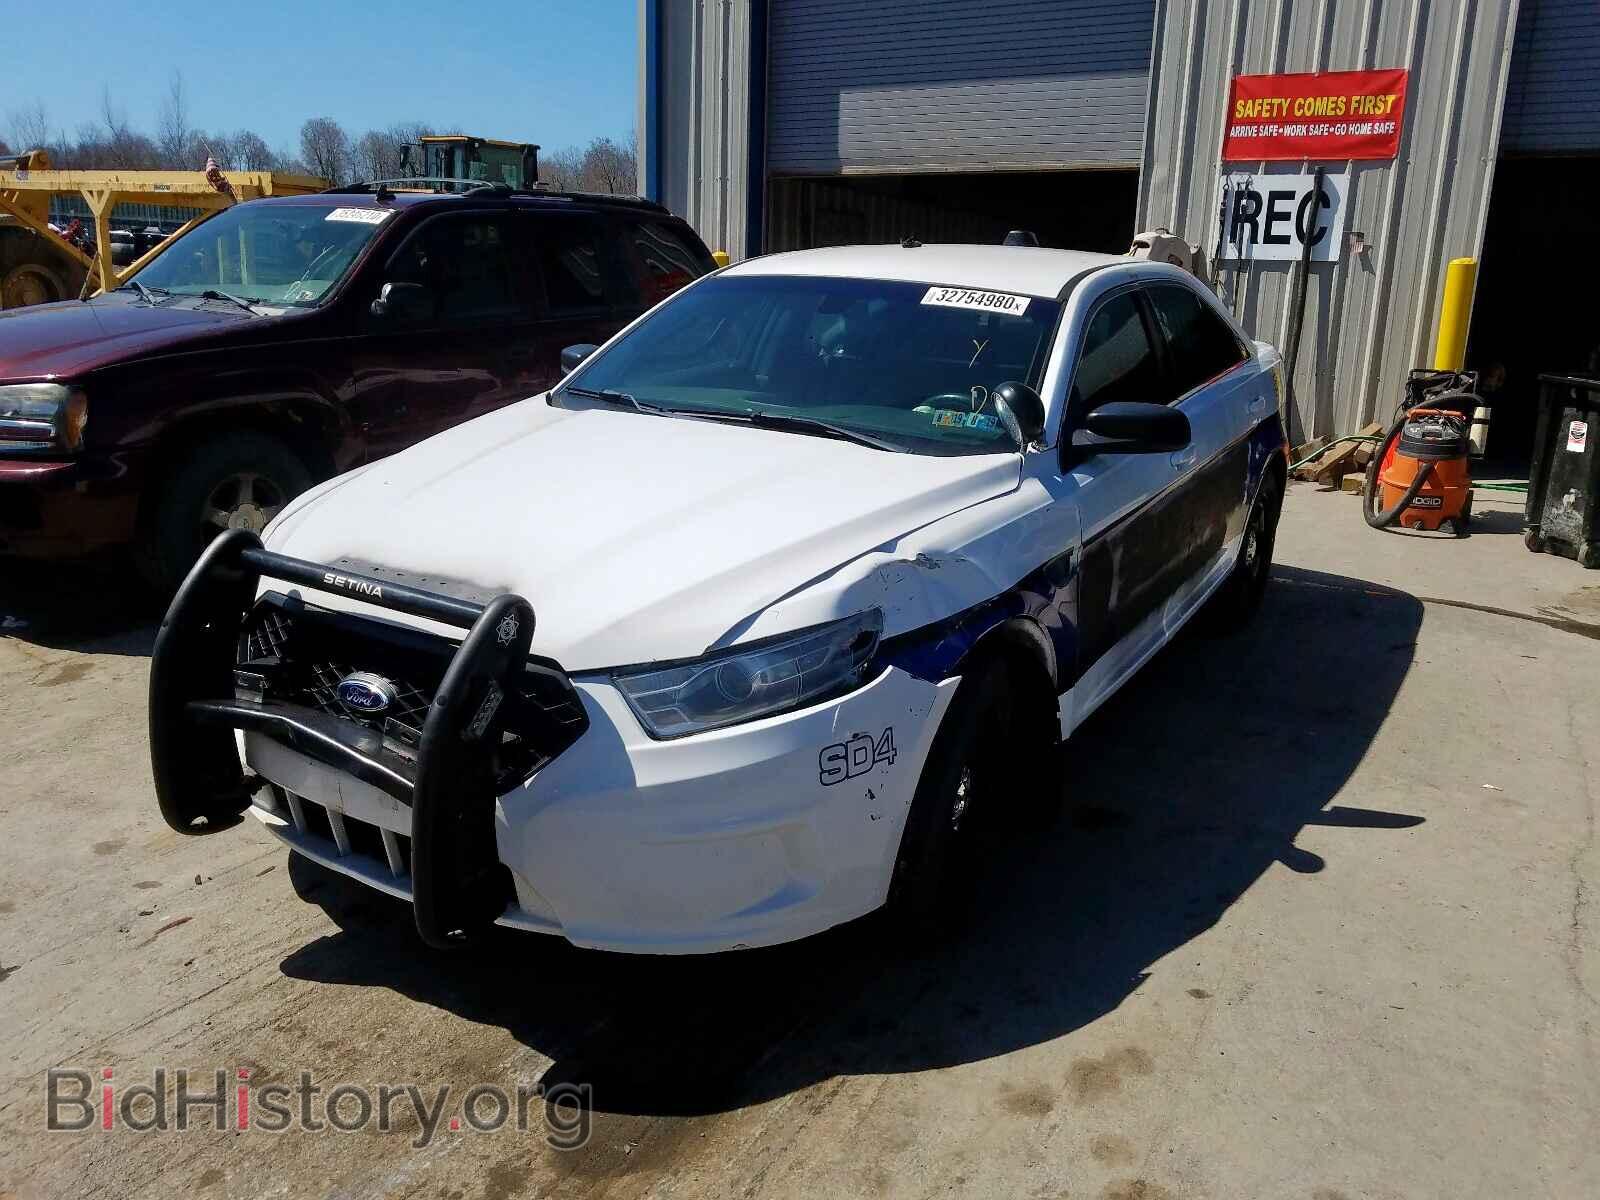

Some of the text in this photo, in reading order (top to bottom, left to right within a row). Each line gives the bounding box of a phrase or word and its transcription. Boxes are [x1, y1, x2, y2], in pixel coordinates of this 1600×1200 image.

[1235, 94, 1396, 118] SAFETY COMES FIRST
[1230, 122, 1395, 137] ARRIVE SAFE WORK SAFE GO HOME SAFE
[1229, 189, 1331, 246] REC
[323, 572, 383, 599] SETINA
[346, 685, 375, 707] Ford
[819, 727, 898, 786] SD4
